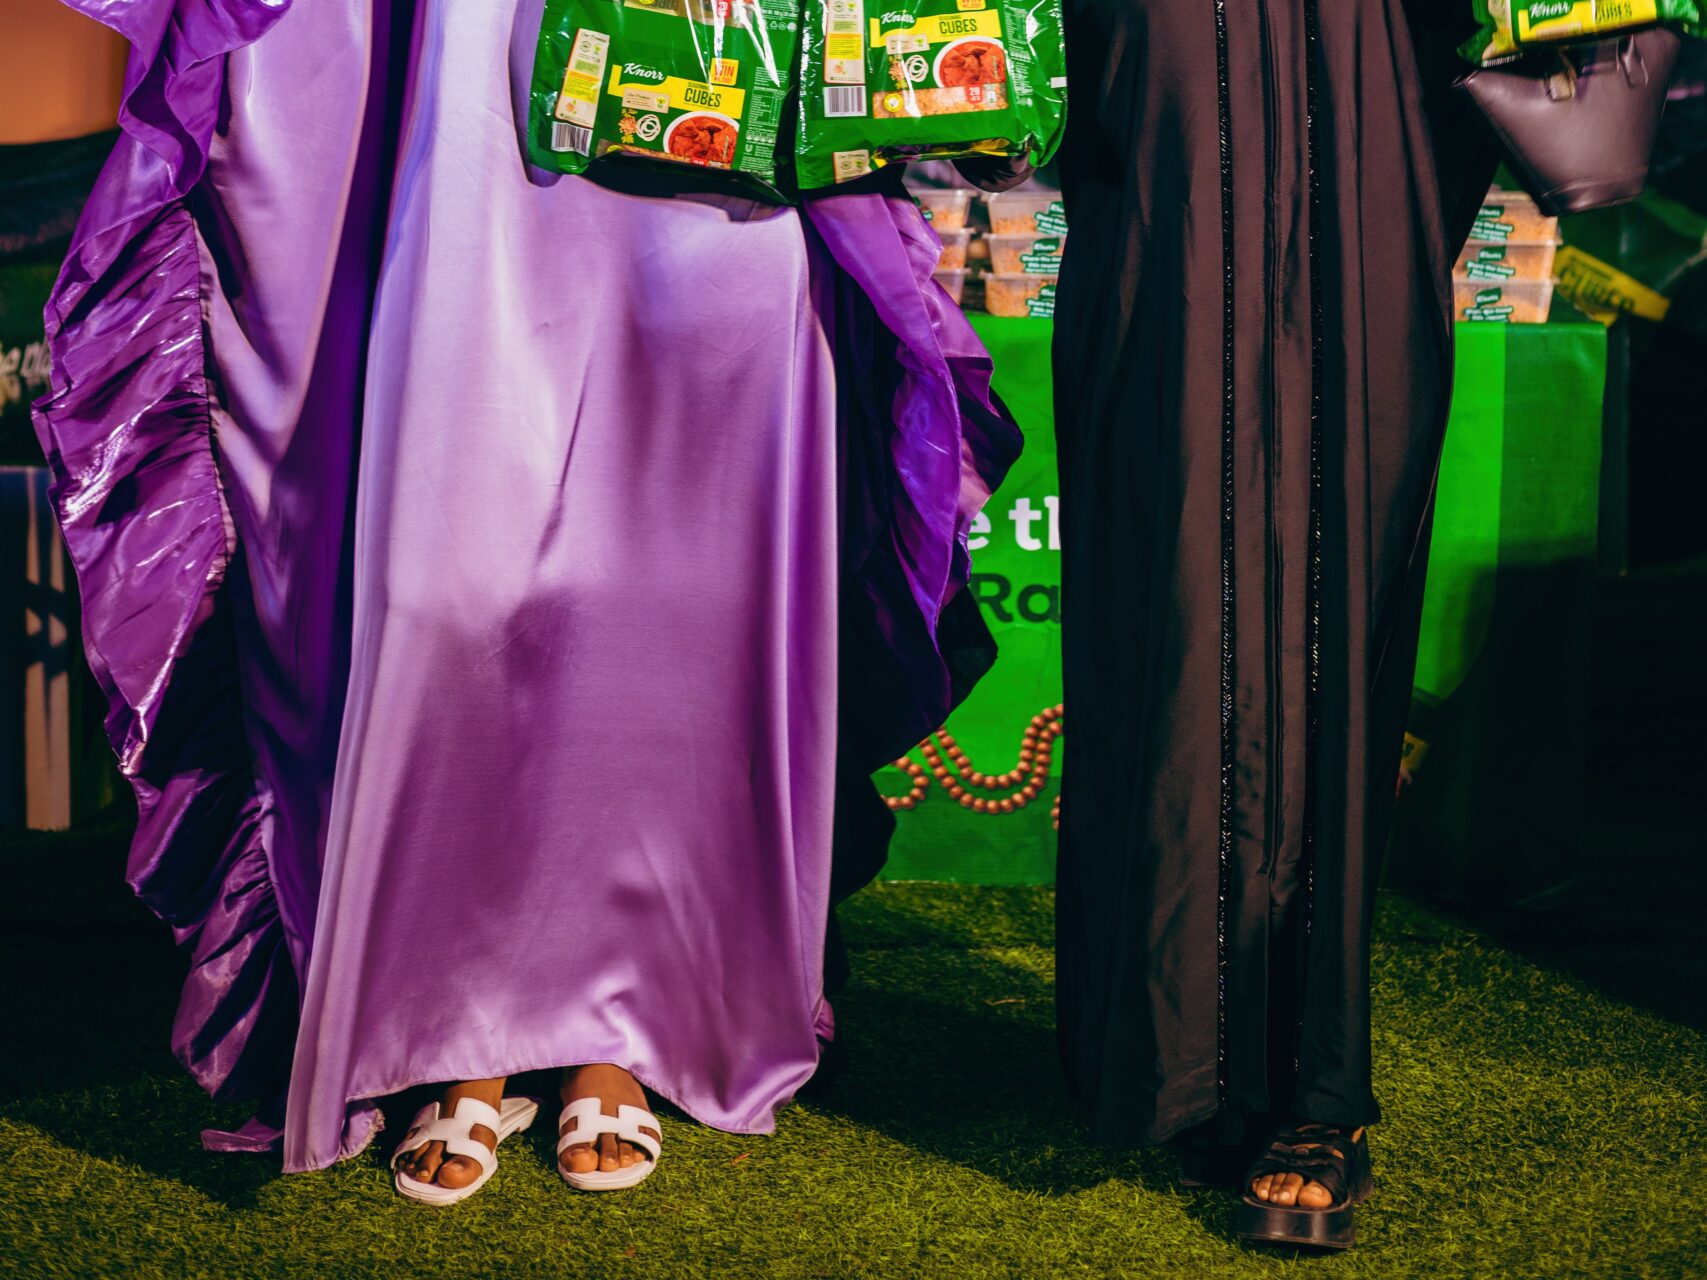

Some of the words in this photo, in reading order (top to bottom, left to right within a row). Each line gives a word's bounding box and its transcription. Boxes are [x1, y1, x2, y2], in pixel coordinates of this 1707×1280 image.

[1530, 1, 1570, 18] Knorr
[939, 19, 978, 35] CUBES
[623, 62, 665, 81] Knorr
[684, 88, 722, 108] CUBES
[968, 86, 981, 96] 20
